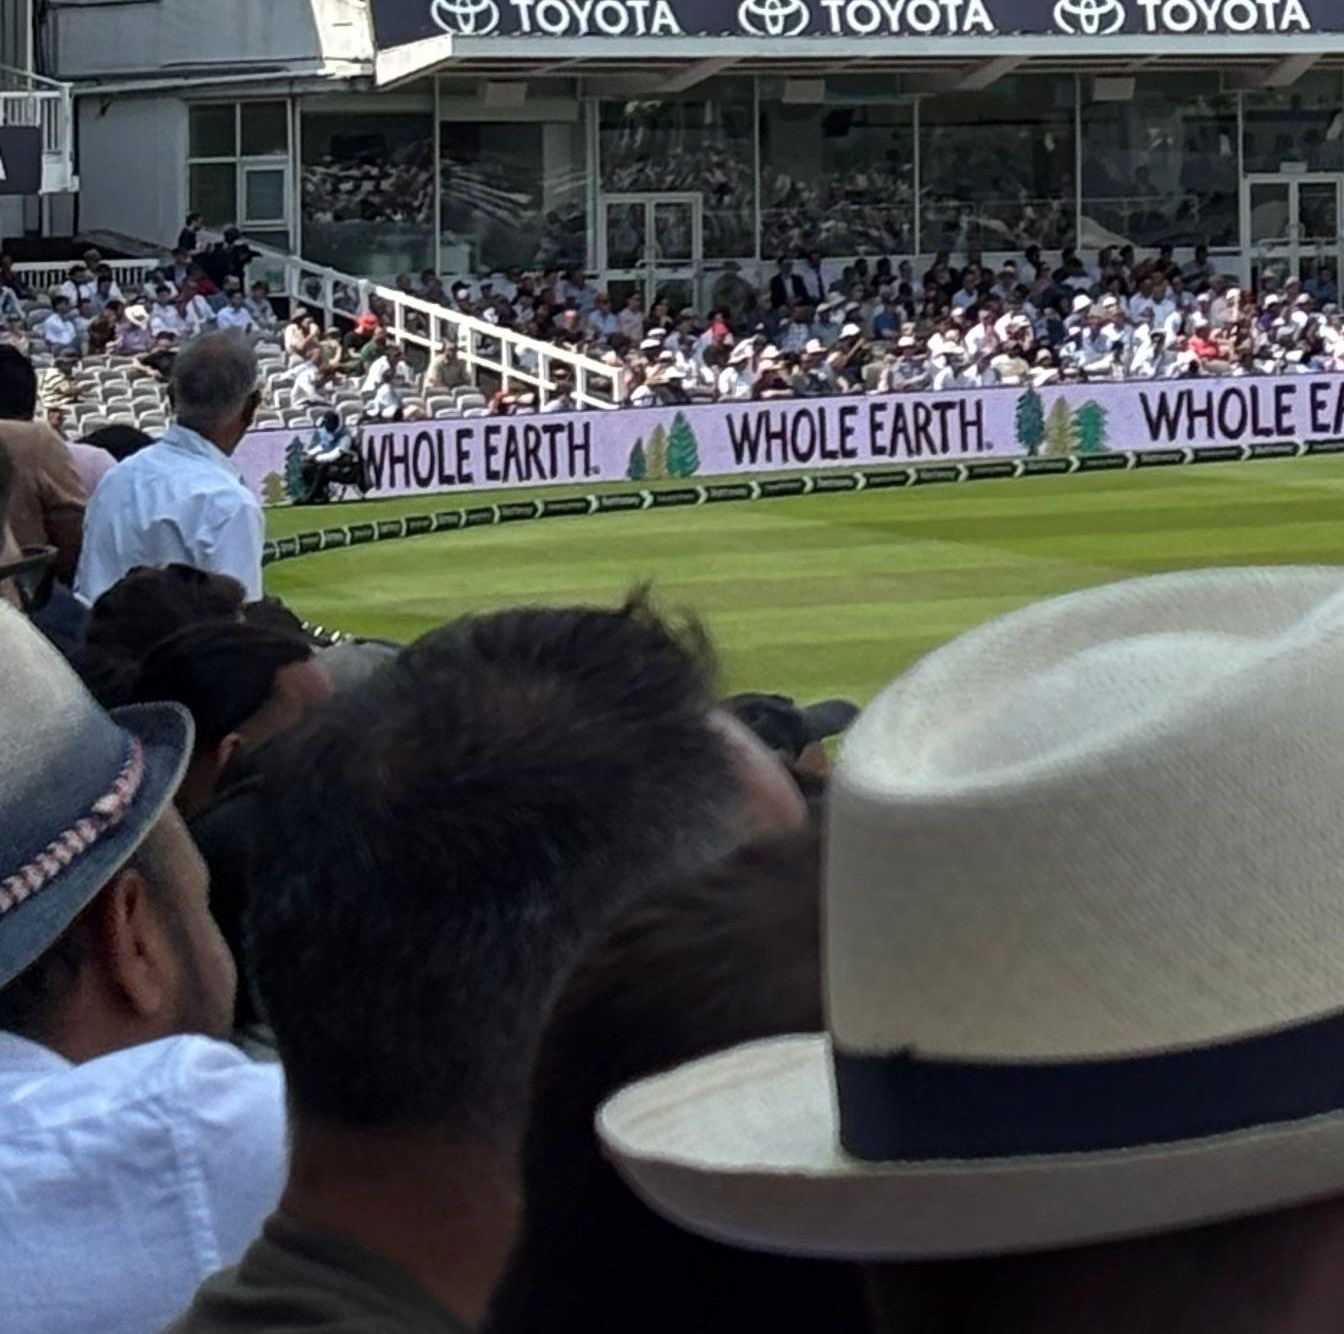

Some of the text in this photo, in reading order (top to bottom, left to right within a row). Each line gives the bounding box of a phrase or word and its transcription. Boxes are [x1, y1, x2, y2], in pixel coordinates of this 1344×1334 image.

[726, 398, 984, 465] WHOLE EARTH
[1140, 382, 1296, 441] WHOLE
[484, 421, 591, 482] EARTH
